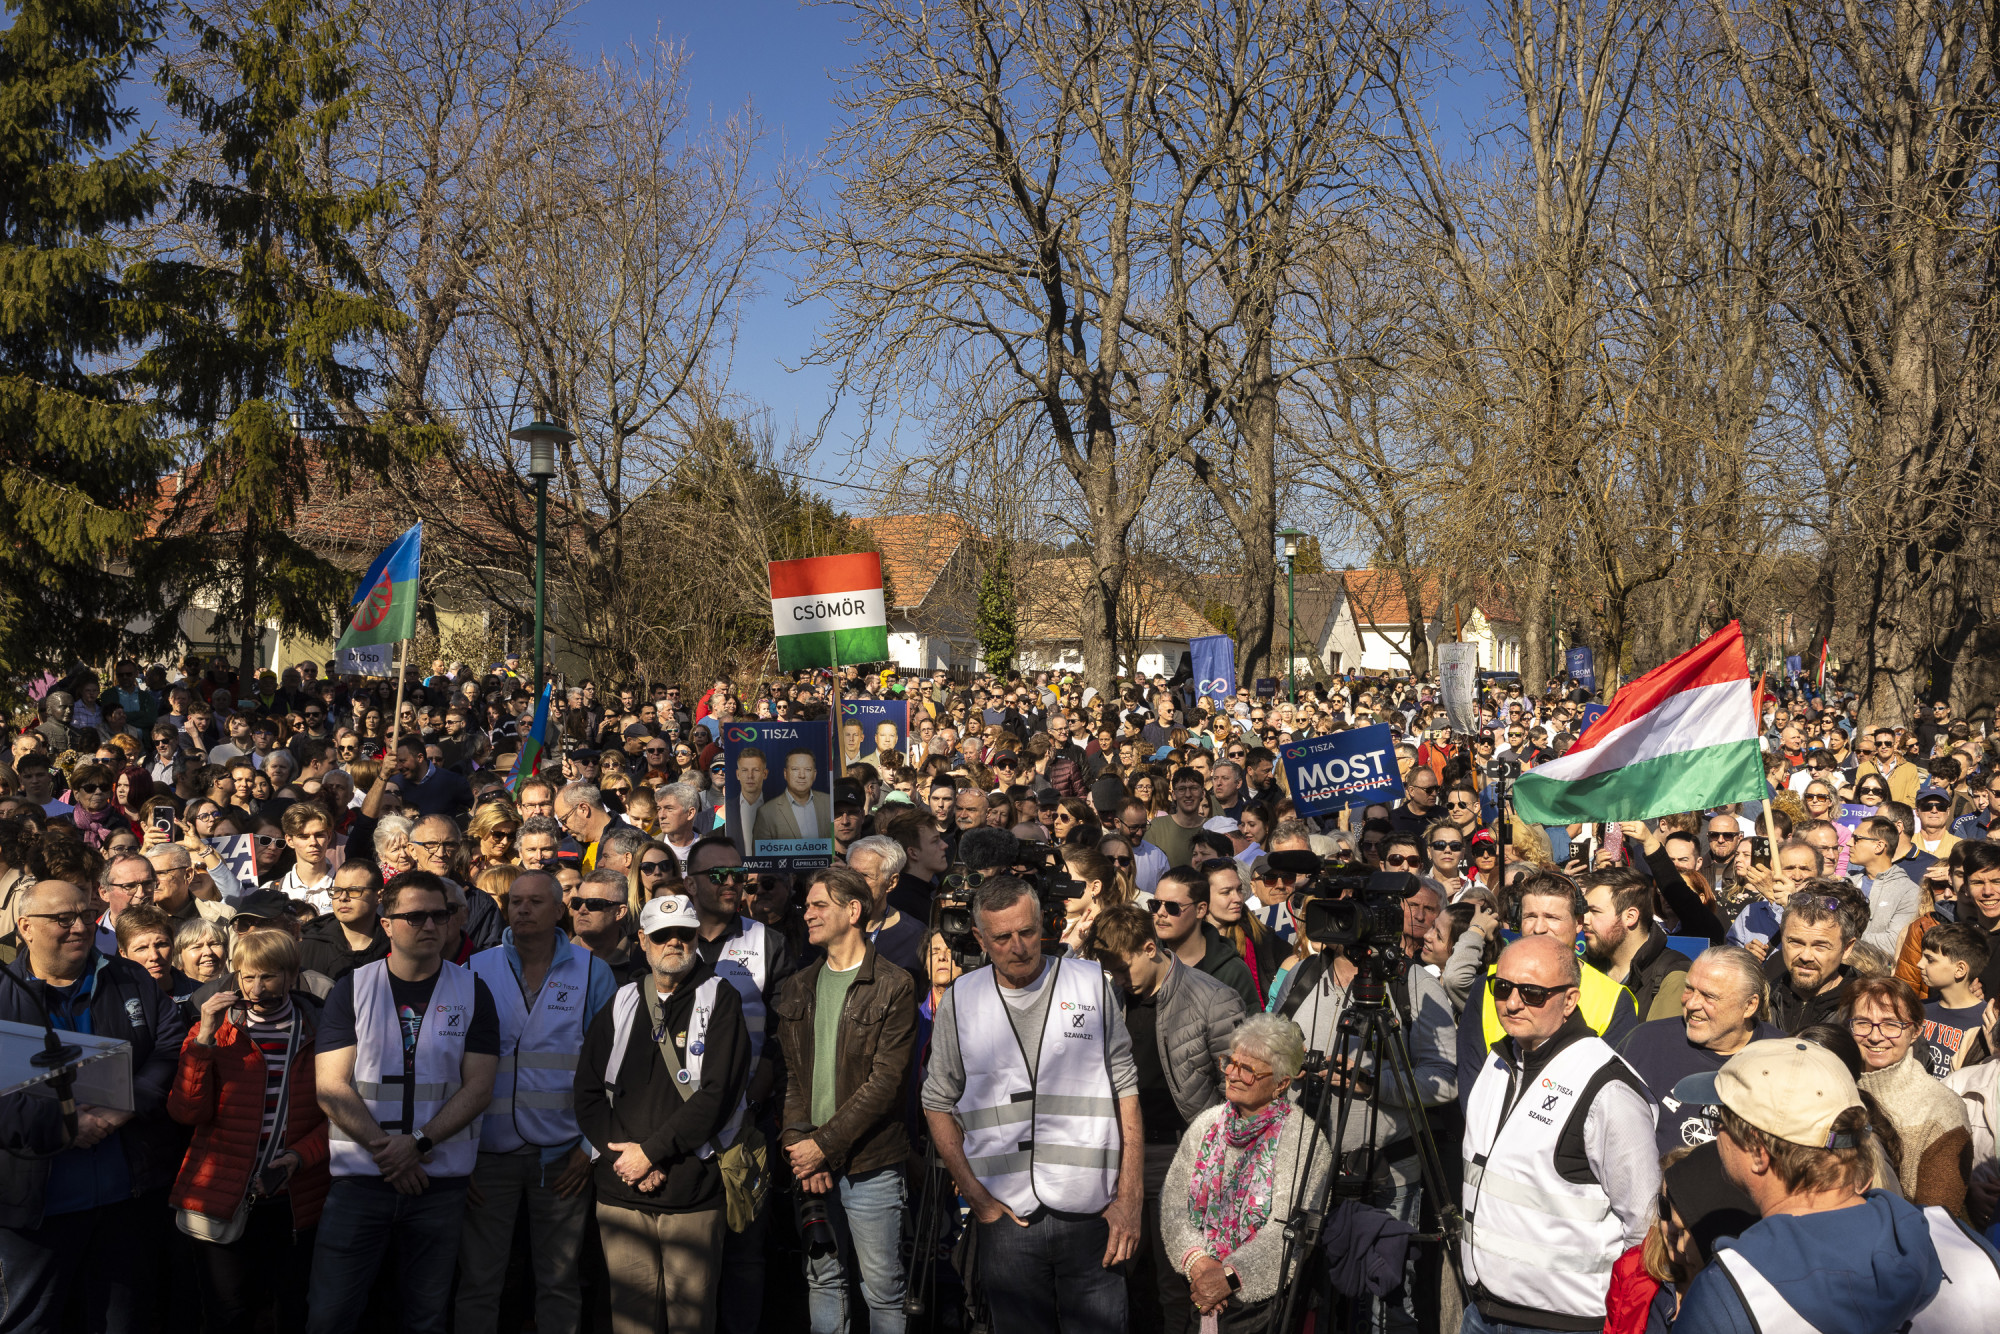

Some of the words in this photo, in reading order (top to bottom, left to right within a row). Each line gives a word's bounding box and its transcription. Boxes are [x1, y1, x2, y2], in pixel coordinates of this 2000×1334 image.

[793, 598, 866, 621] CSÖMÖR
[348, 652, 380, 662] DIÓSD
[860, 705, 887, 714] TISZA
[762, 728, 799, 740] TISZA
[1309, 742, 1335, 754] TISZA
[1298, 749, 1386, 790] MOST
[1300, 784, 1340, 803] VAGY
[1343, 774, 1393, 795] SOHA!
[760, 843, 793, 852] PÓSFAI
[795, 842, 828, 851] GÁBOR
[742, 861, 773, 869] AVAZZ!
[562, 983, 579, 991] TISZA
[1077, 1003, 1097, 1011] TISZA
[1937, 1022, 1964, 1053] YOR
[1556, 1084, 1574, 1097] TISZA
